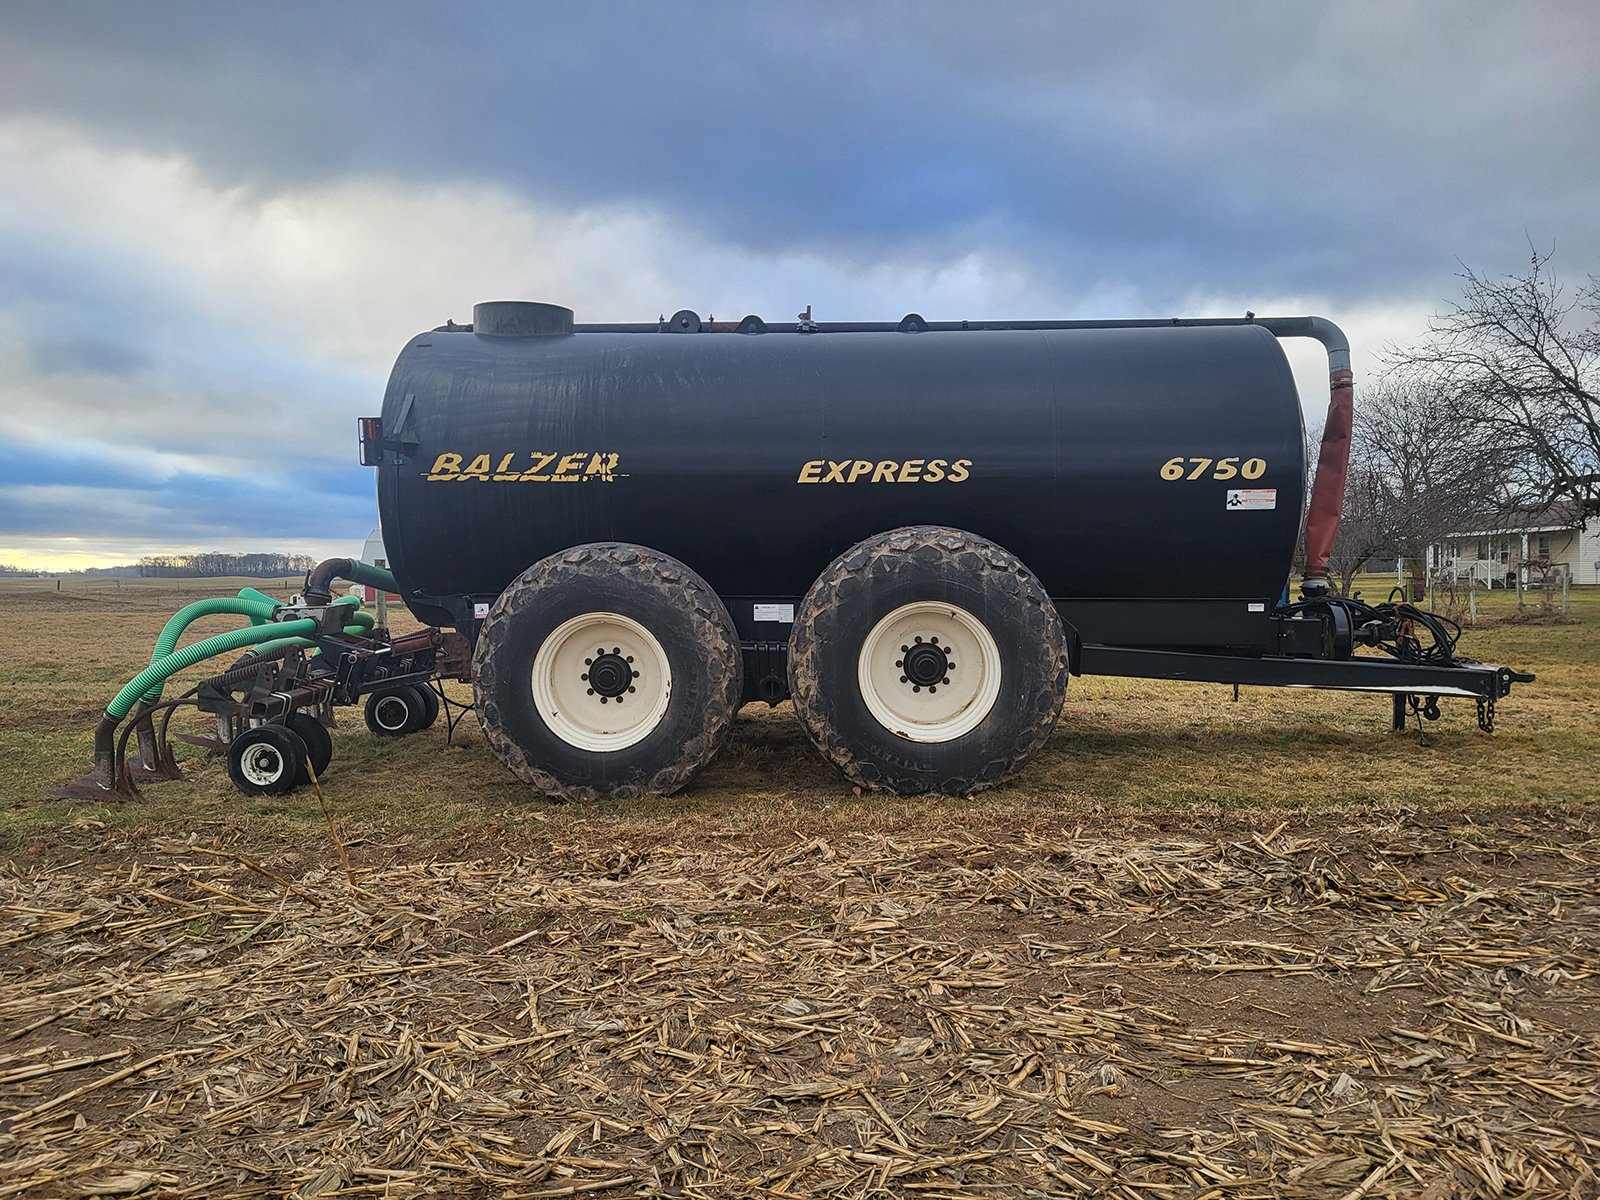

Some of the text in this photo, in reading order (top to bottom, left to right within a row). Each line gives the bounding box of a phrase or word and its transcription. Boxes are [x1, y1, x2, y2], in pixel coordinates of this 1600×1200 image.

[426, 452, 620, 483] BALZER
[797, 459, 972, 484] EXPRESS
[1160, 457, 1267, 481] 6750
